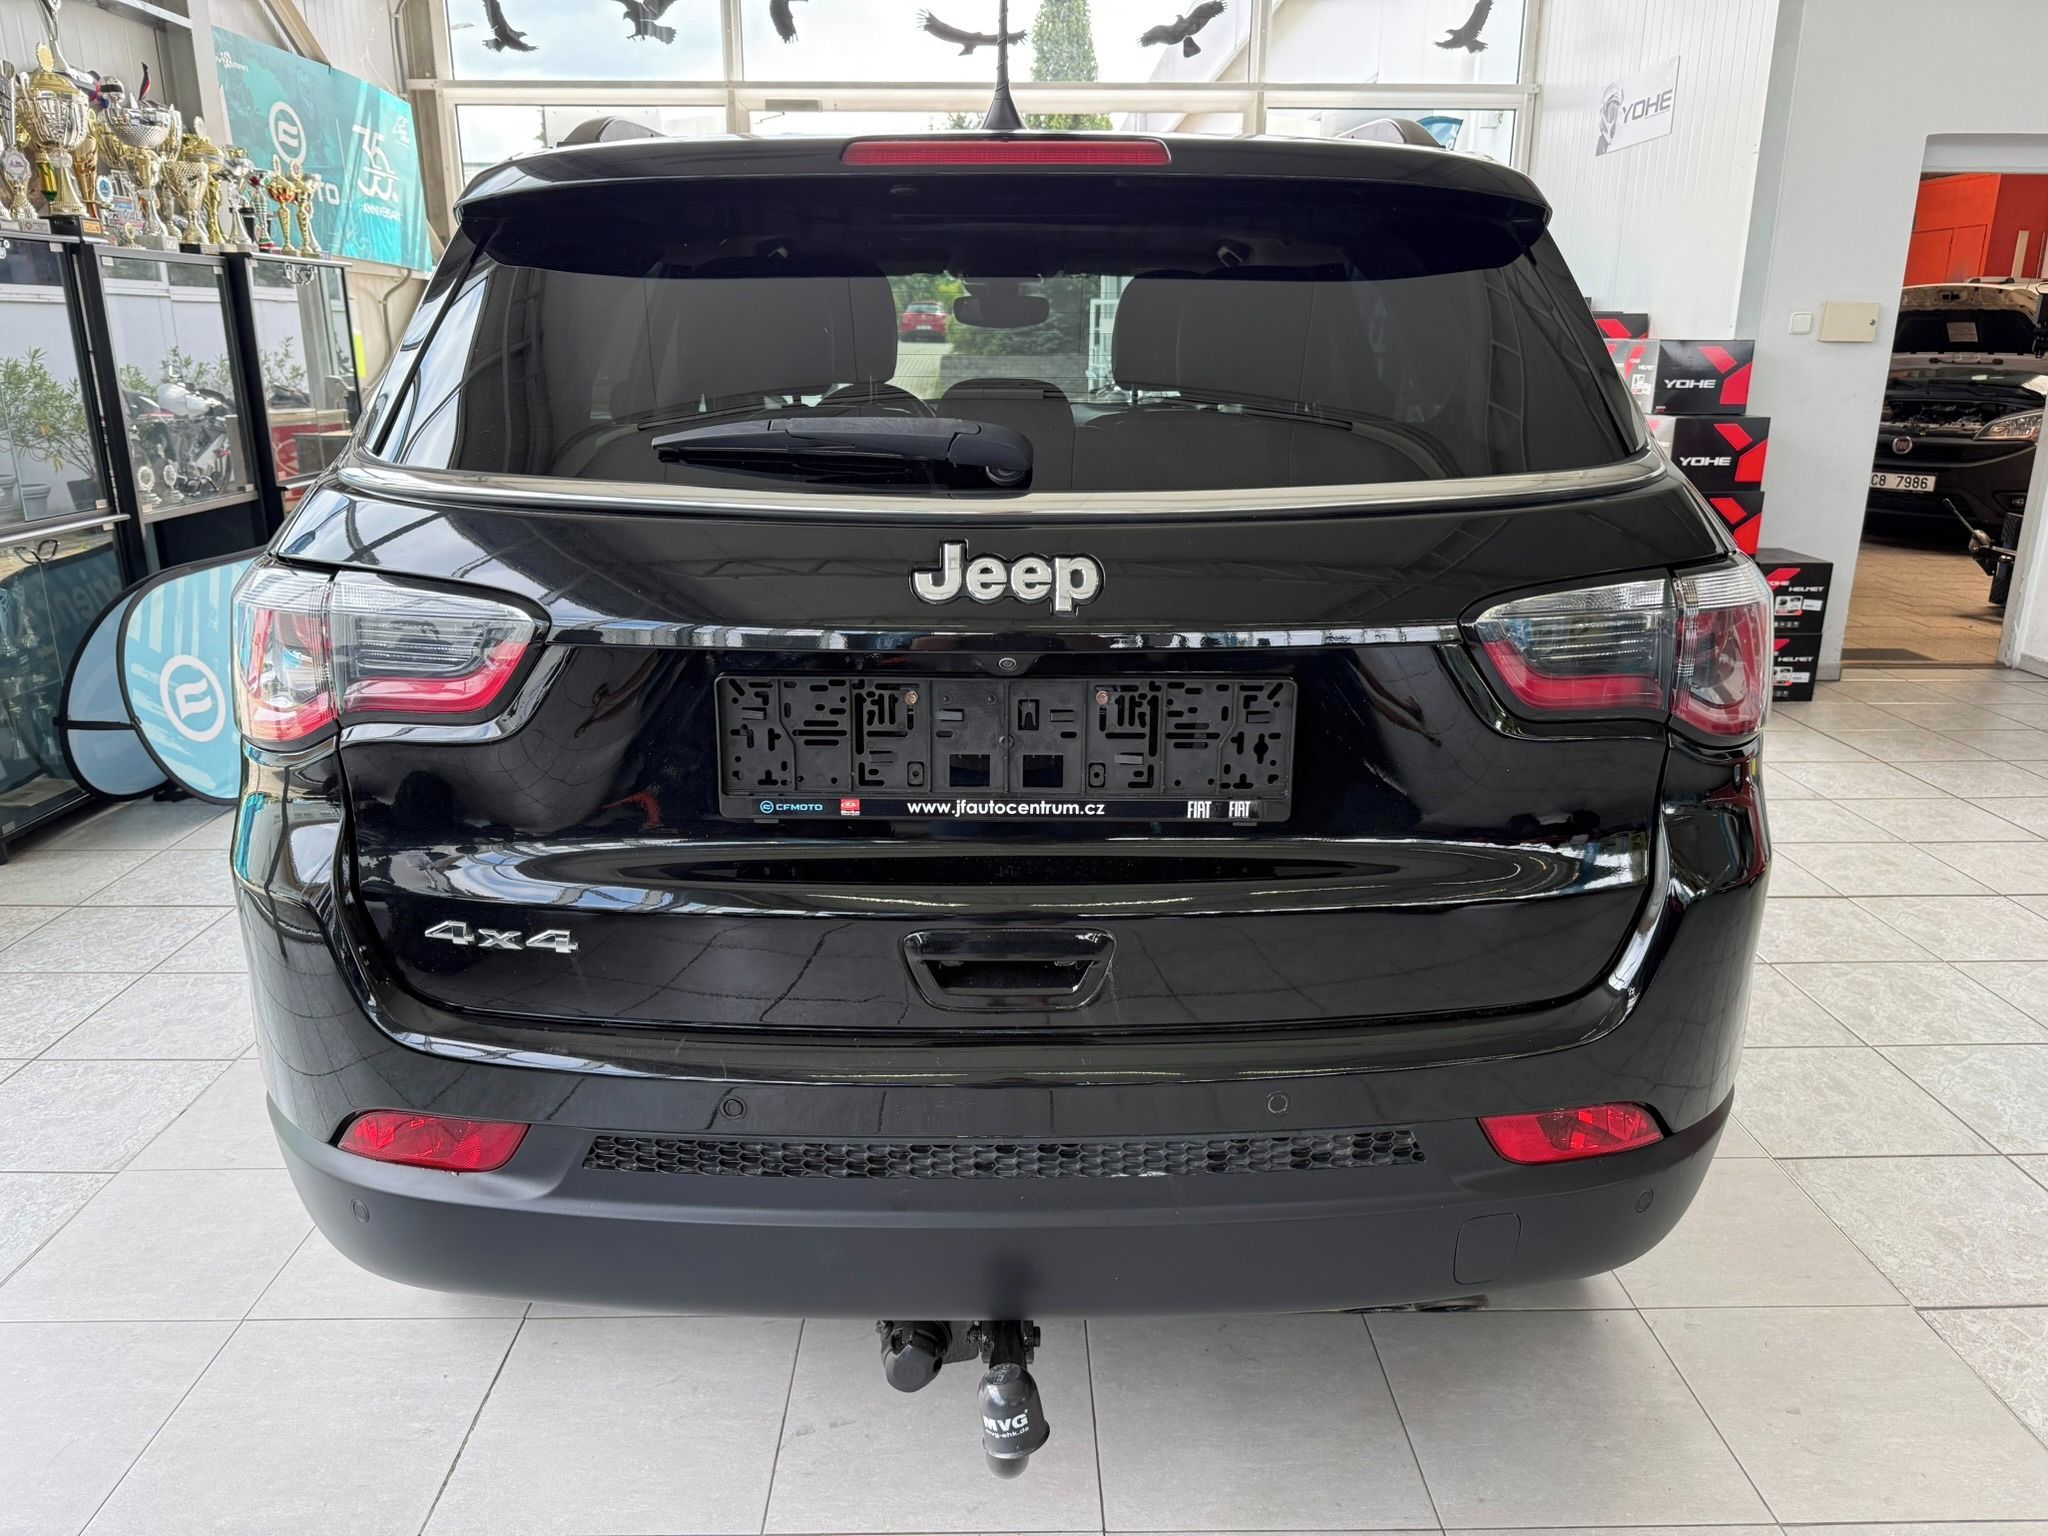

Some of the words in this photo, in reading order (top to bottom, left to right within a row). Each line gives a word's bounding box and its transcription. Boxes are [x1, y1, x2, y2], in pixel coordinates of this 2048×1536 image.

[1622, 88, 1673, 124] YOHE
[1663, 379, 1716, 389] YOHE
[1679, 456, 1732, 466] YOHE
[1895, 475, 1929, 490] 7986
[912, 541, 1103, 614] Jeep
[775, 803, 823, 811] CFMOTO
[907, 800, 1105, 817] www.jfautocentrum.cz
[1187, 800, 1212, 819] FIAT
[1228, 801, 1251, 818] FIAT
[424, 920, 579, 954] 4x4
[982, 1413, 1029, 1432] MVG
